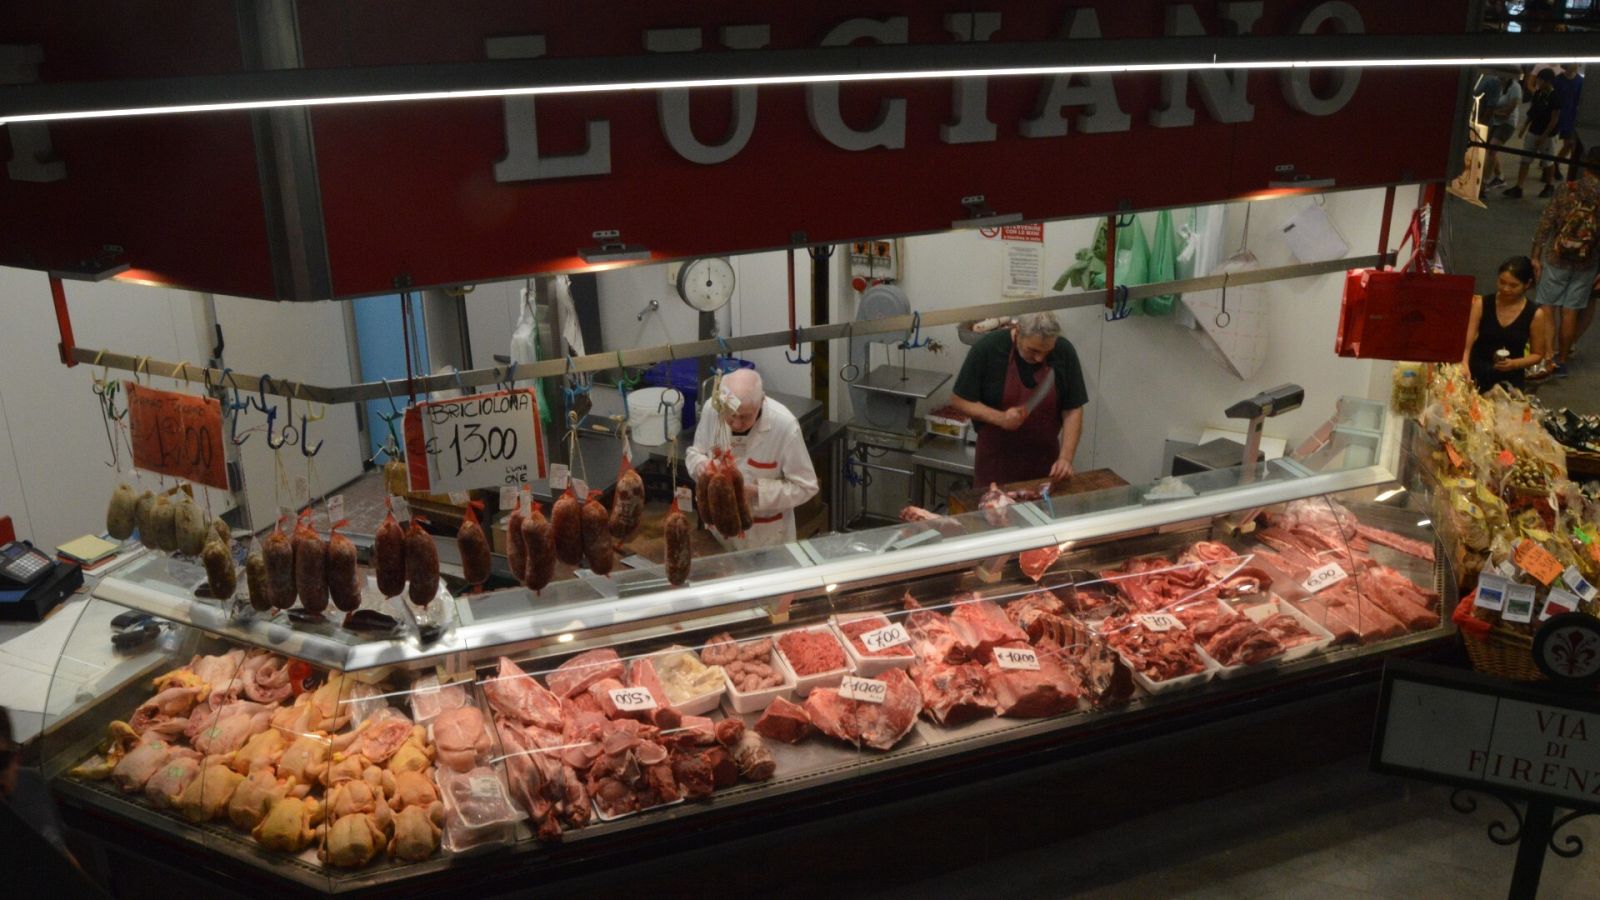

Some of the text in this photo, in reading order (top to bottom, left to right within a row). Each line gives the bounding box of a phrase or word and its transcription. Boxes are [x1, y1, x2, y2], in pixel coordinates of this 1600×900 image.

[485, 0, 1366, 183] LUCIANO
[1536, 709, 1588, 741] VIA
[1545, 741, 1568, 758] DI
